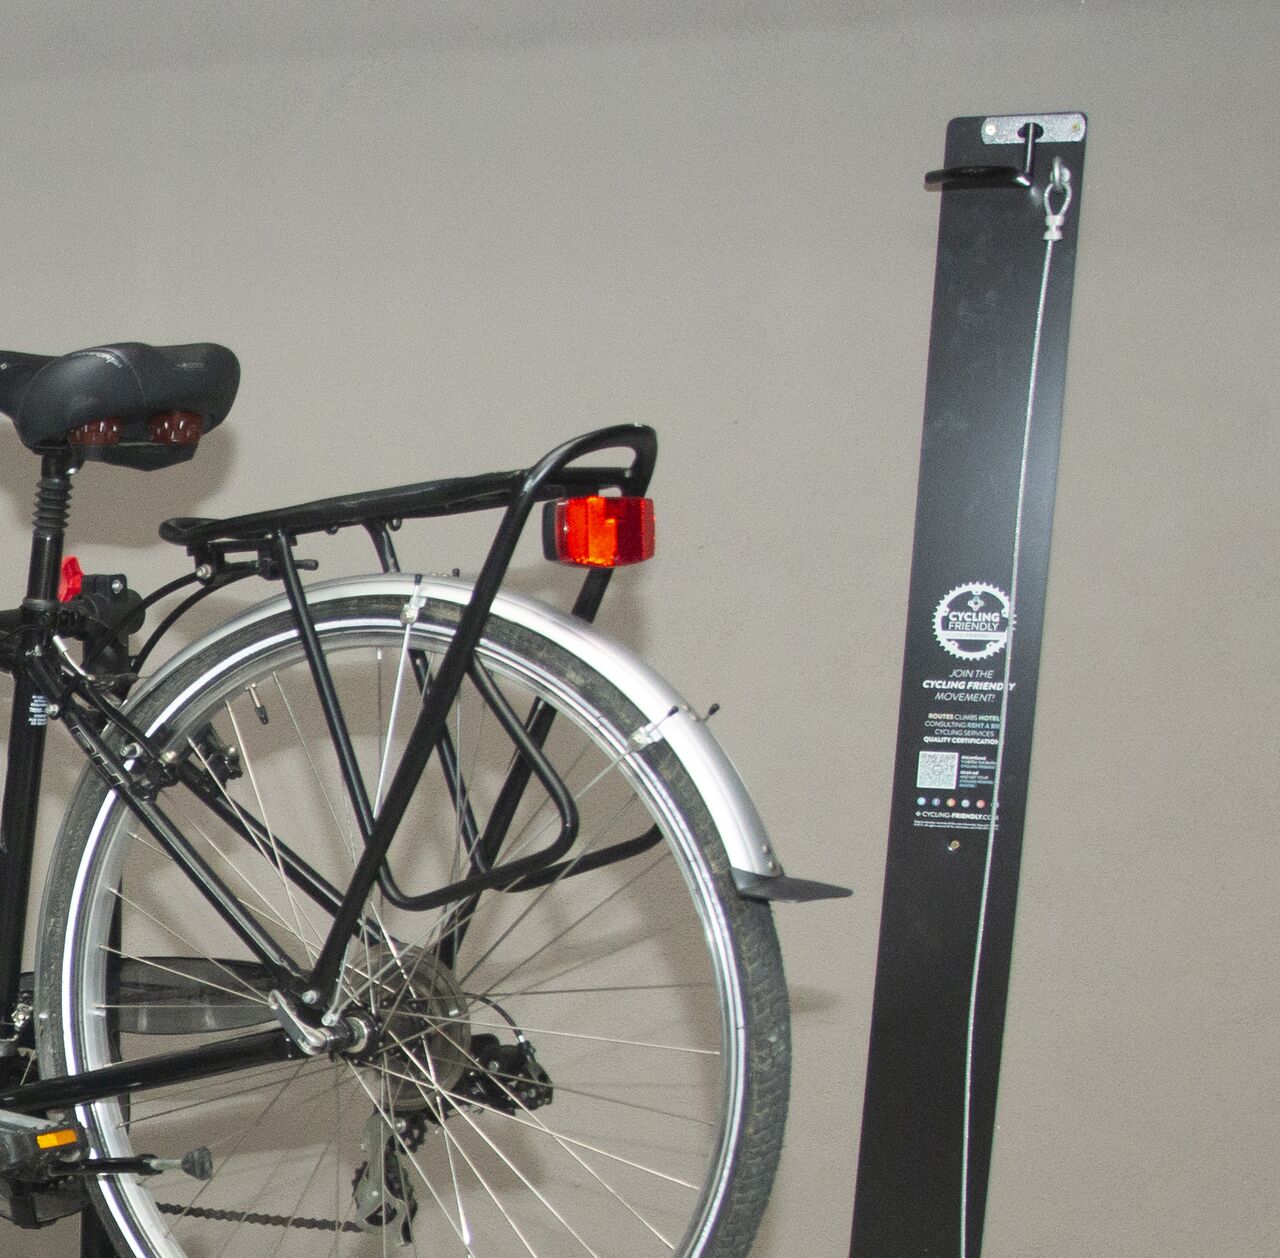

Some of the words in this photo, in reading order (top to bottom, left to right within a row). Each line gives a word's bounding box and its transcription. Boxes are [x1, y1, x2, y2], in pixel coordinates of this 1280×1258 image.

[948, 611, 1000, 623] CYCLING
[948, 621, 1000, 631] FRIENDLY
[949, 669, 973, 678] JOIN
[975, 669, 994, 679] THE
[922, 680, 966, 690] CYCLING
[966, 681, 1016, 691] FRIENDY
[934, 692, 996, 702] MOVEMENT!
[924, 720, 967, 729] CONSULTING
[922, 811, 999, 820] CYCLING-FRIENDLY.CO
